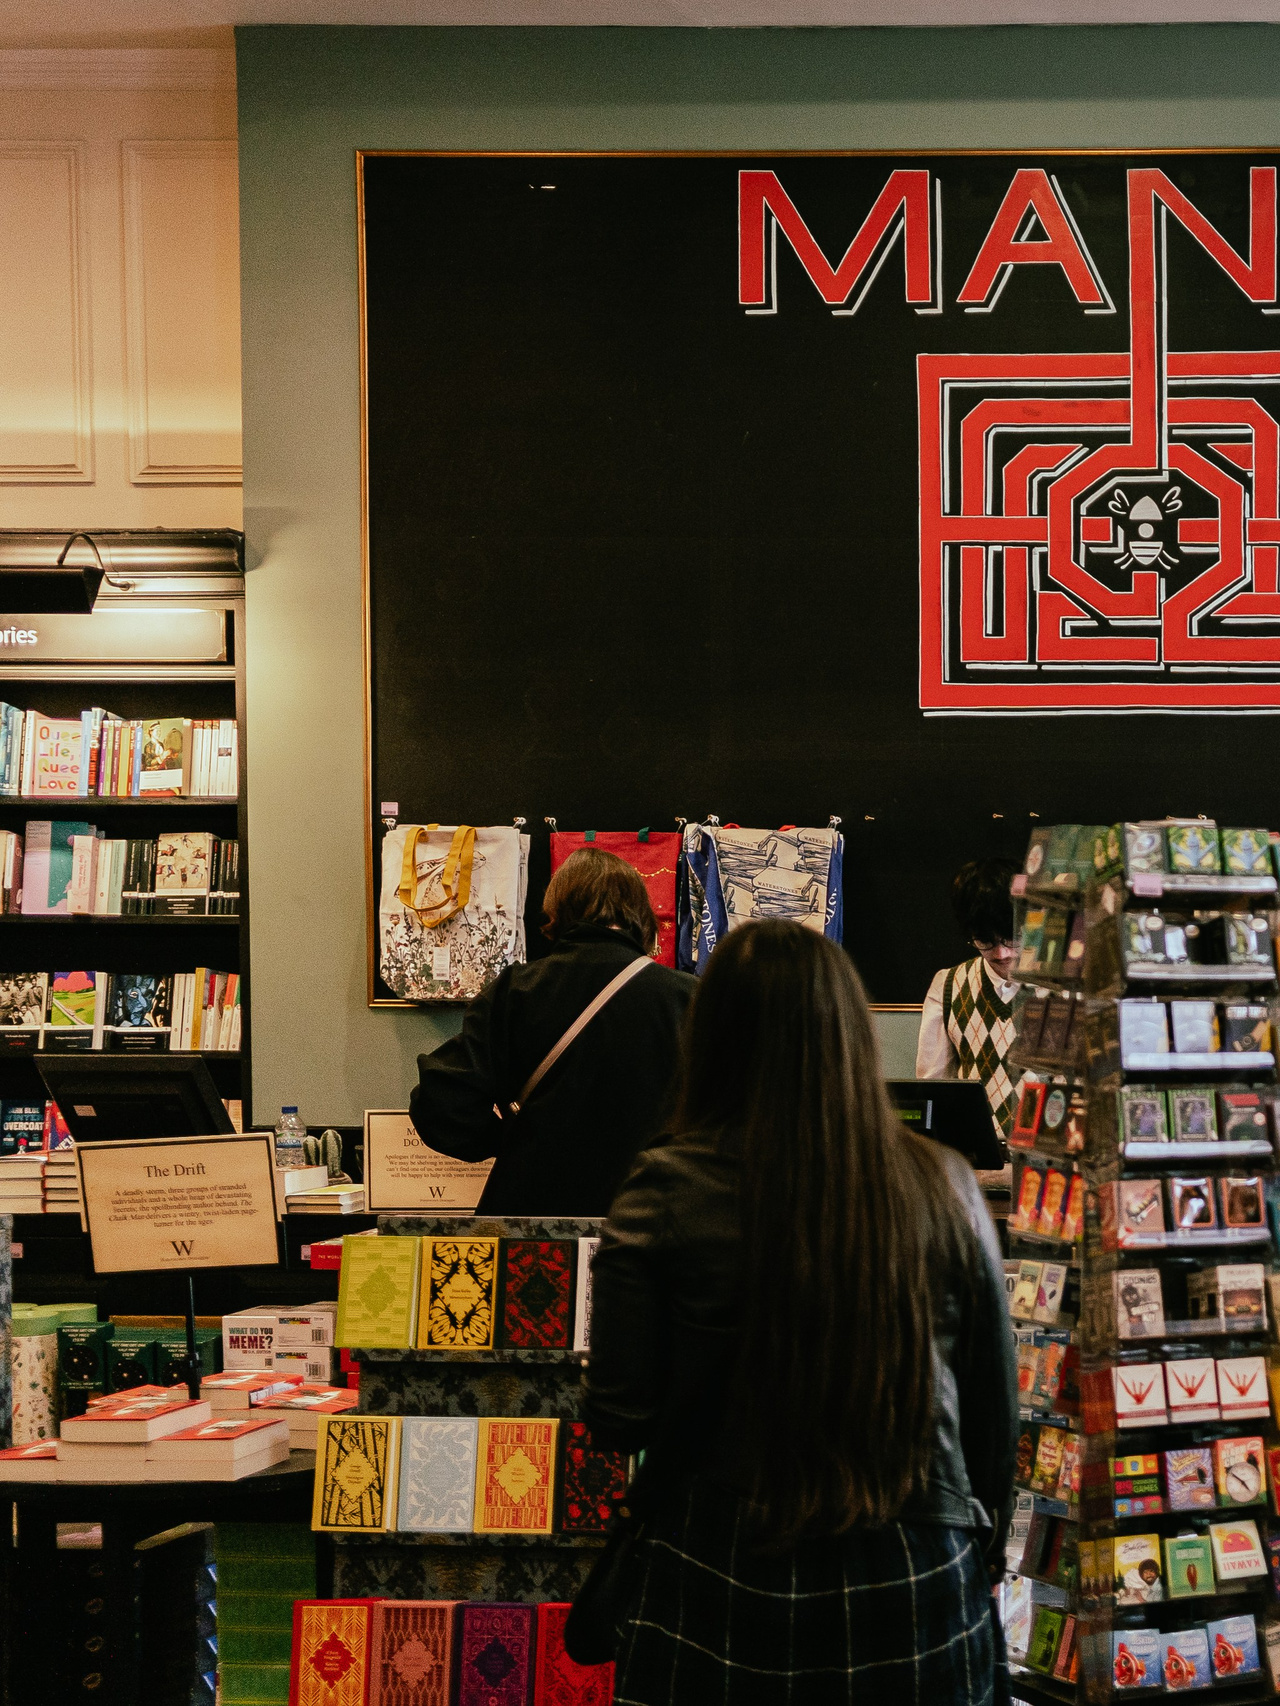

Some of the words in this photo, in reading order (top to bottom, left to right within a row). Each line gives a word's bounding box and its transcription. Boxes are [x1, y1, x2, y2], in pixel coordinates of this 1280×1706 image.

[40, 726, 81, 741] Quee
[38, 758, 80, 774] Quee
[39, 775, 77, 790] Love
[718, 836, 754, 848] WATERSTONES
[757, 881, 799, 894] WATERSTONES
[3, 1122, 44, 1131] OVERCOAT
[143, 1165, 170, 1178] The
[174, 1162, 206, 1176] Drift
[429, 1186, 446, 1198] W
[171, 1240, 194, 1257] W
[228, 1327, 248, 1335] WHAT
[249, 1327, 259, 1335] DO
[260, 1327, 274, 1335] YOU
[229, 1335, 274, 1349] MEME?
[1134, 1484, 1158, 1494] GAMES
[1223, 1558, 1261, 1571] KAWAII
